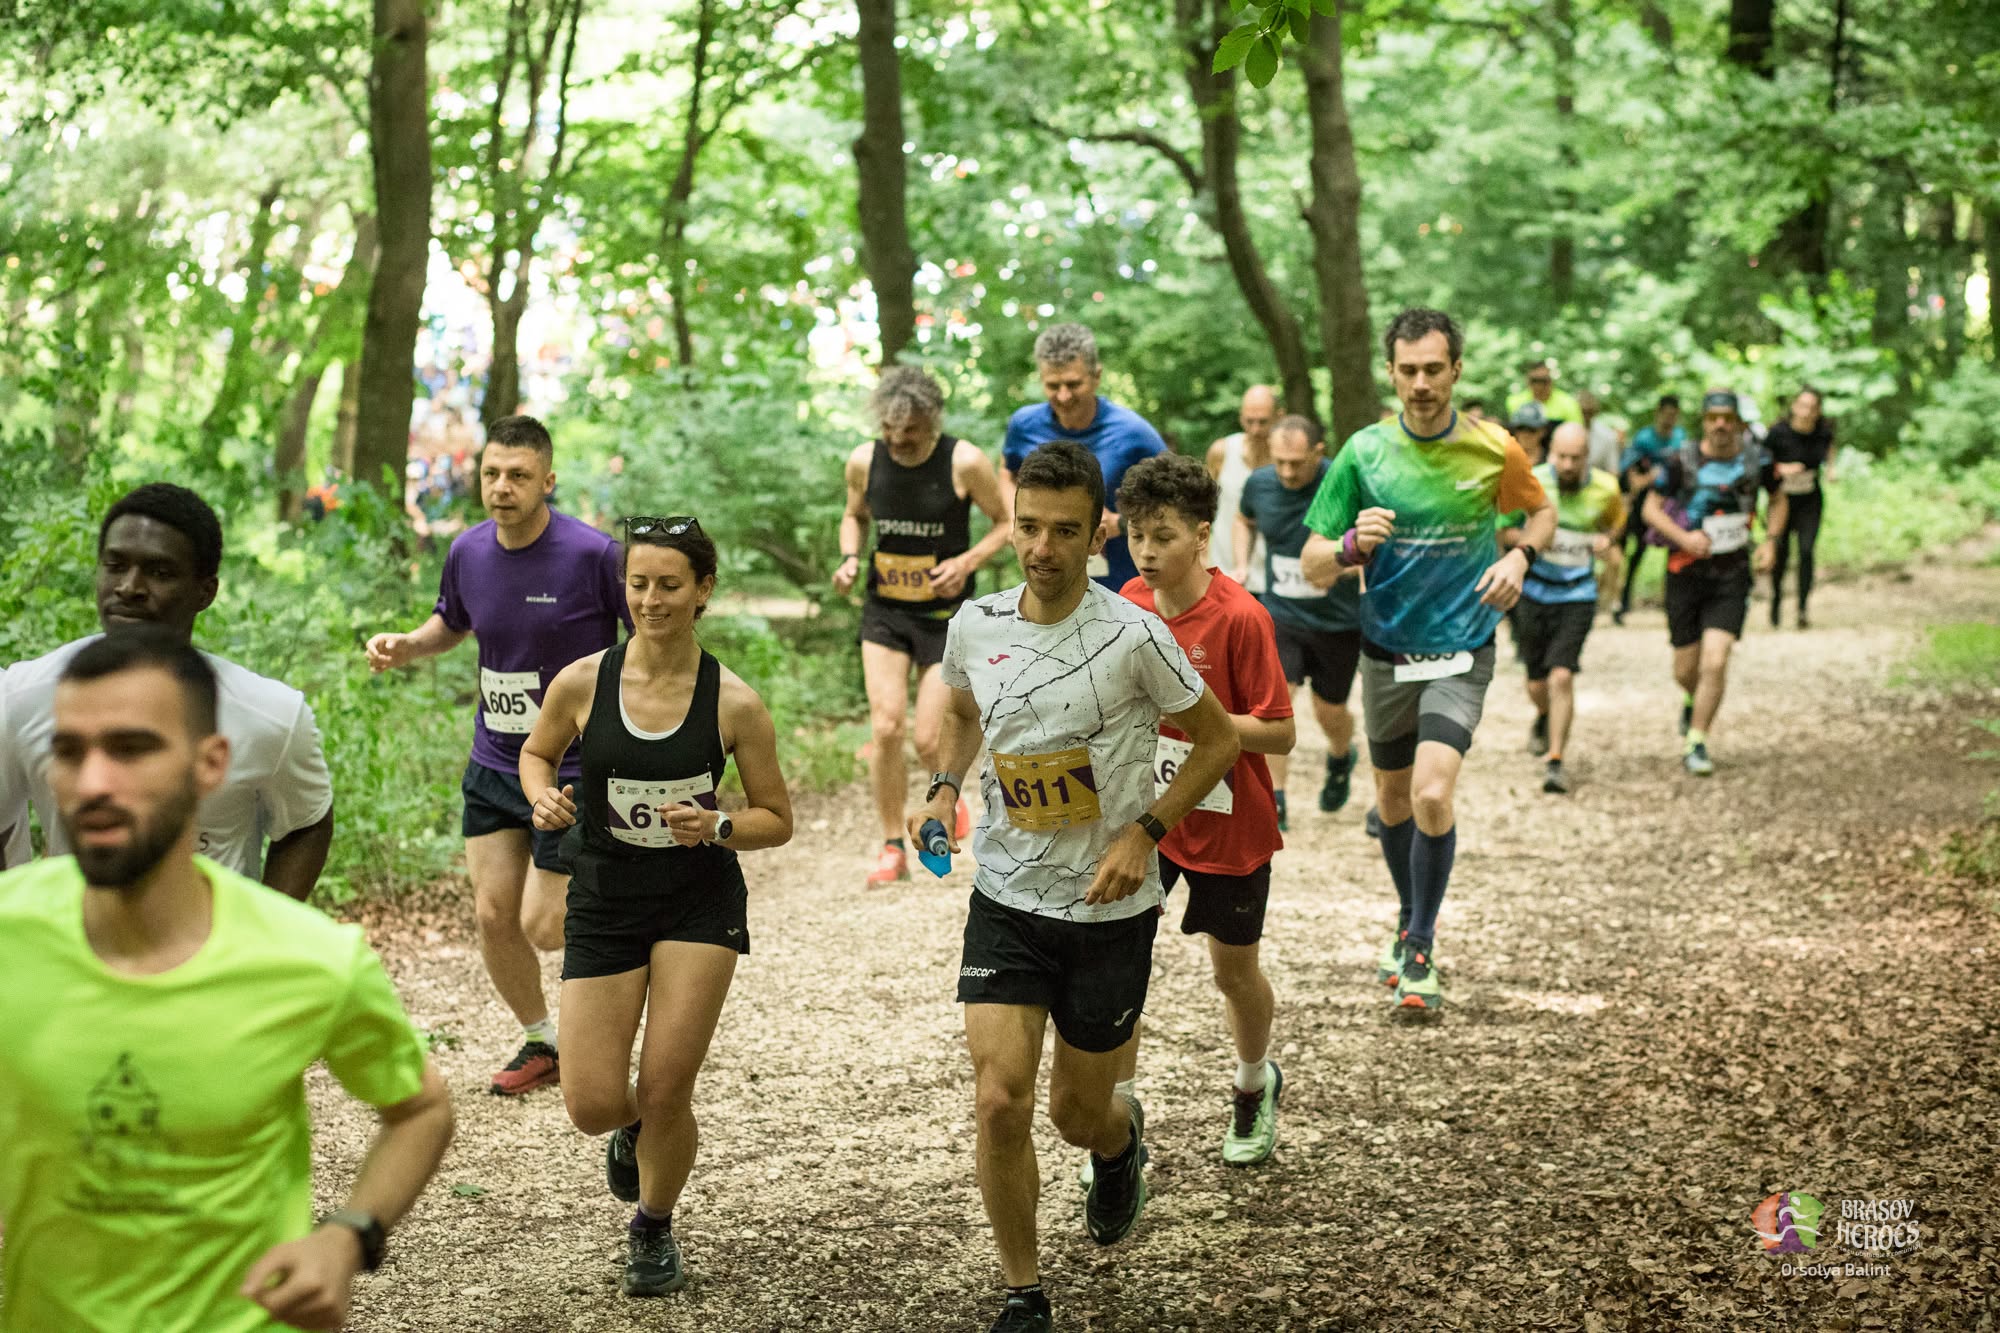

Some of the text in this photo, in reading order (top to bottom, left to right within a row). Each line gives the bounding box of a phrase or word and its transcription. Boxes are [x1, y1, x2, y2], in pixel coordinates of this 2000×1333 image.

[886, 568, 924, 587] 619
[489, 690, 527, 716] 605
[1013, 775, 1071, 808] 611
